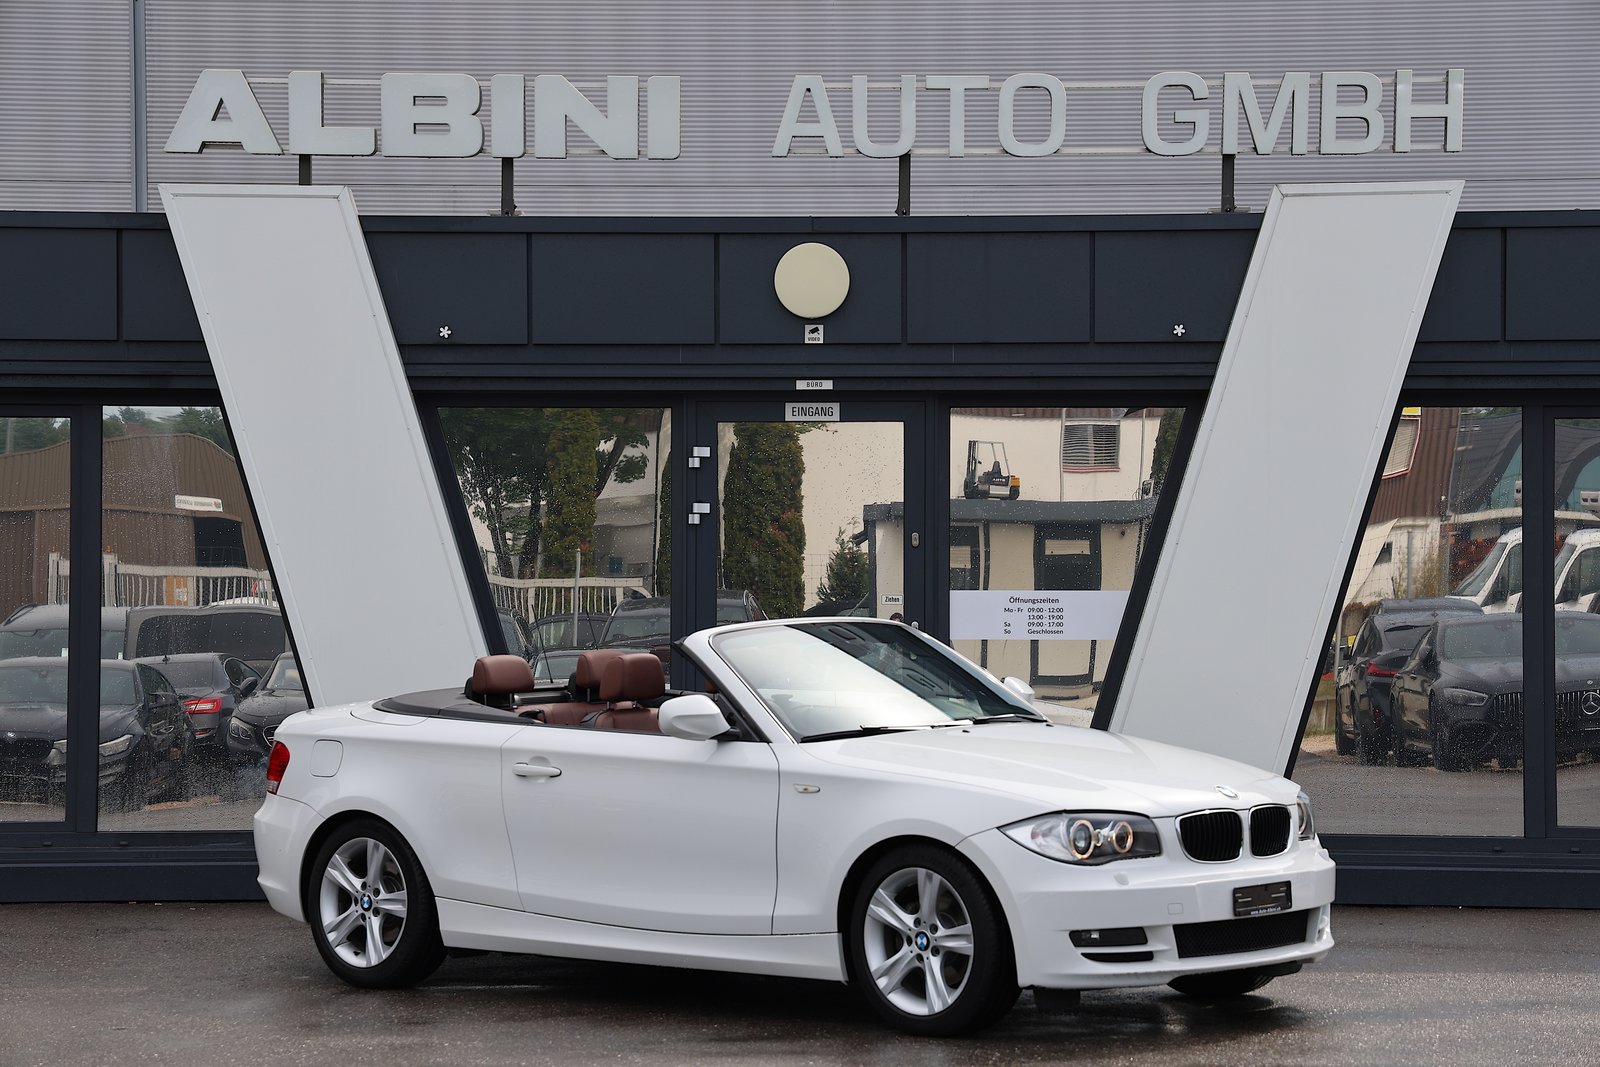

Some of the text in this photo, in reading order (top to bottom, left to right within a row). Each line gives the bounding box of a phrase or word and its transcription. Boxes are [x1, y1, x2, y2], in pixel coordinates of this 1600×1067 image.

[164, 69, 1465, 160] ALBINI AUTO GMBH
[791, 406, 834, 417] EINGANG
[1008, 596, 1060, 605] Öffnungszeiten
